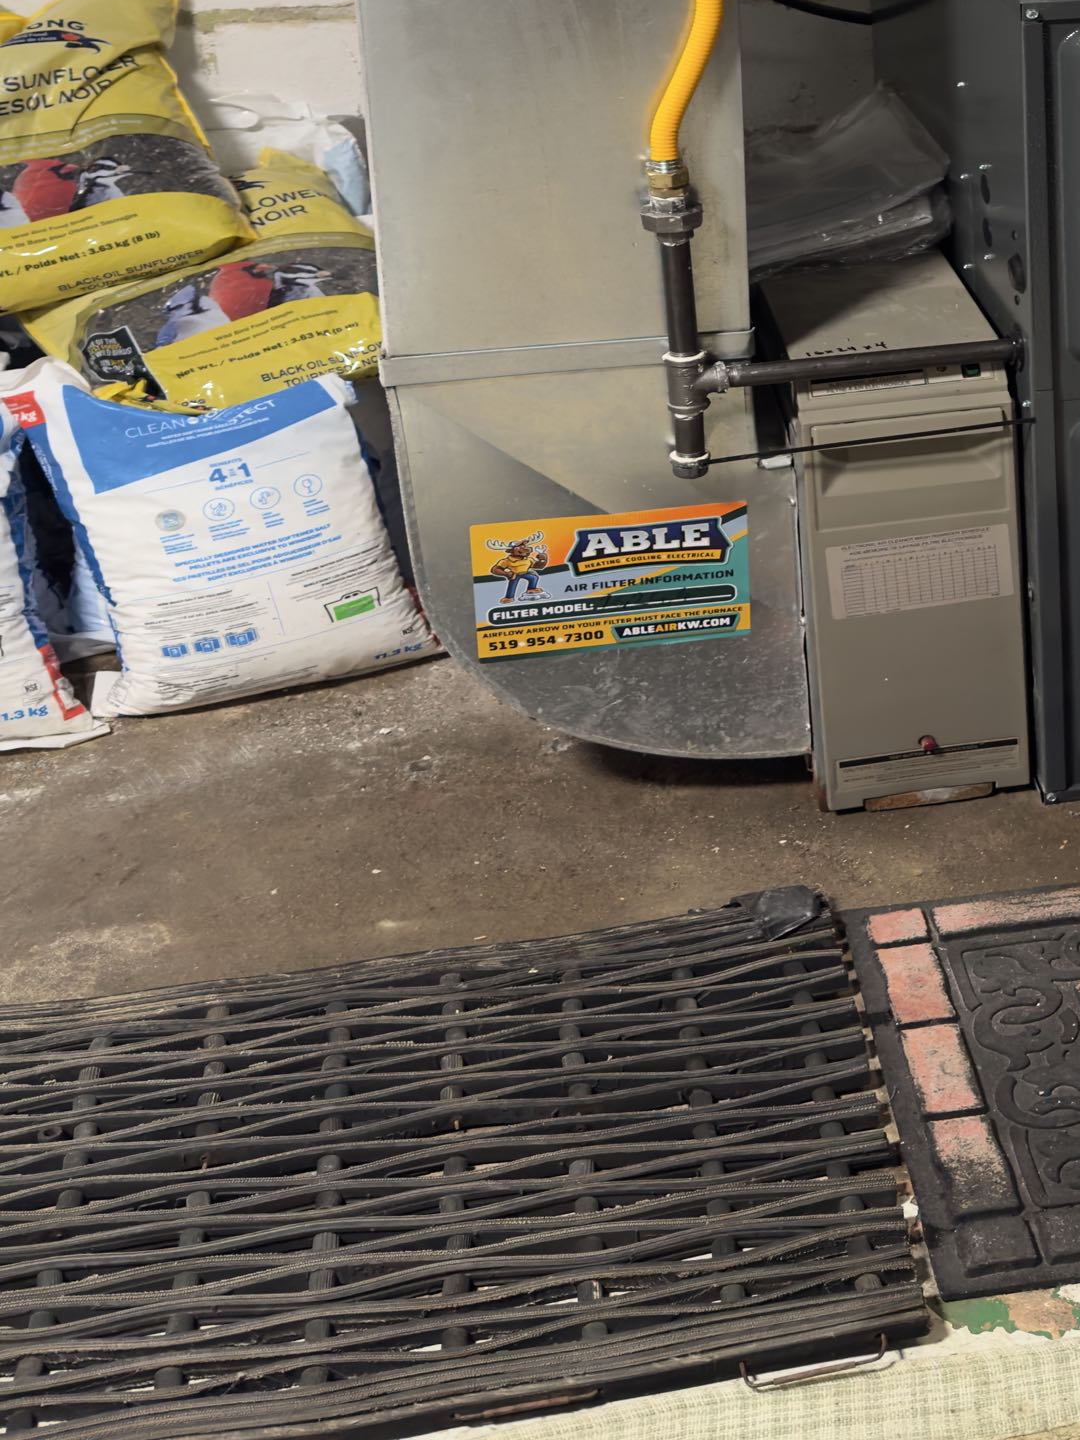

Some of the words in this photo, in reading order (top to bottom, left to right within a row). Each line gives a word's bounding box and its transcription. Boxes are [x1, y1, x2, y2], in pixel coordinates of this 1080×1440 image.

[24, 258, 57, 271] Poids
[59, 252, 80, 262] Net
[115, 238, 130, 249] kg
[58, 275, 100, 293] BLACK
[103, 269, 121, 279] OIL
[125, 249, 204, 273] SUNFLOWER
[261, 363, 305, 383] BLACK
[307, 357, 327, 371] OIL
[124, 417, 186, 440] CLEAN
[581, 522, 710, 558] ABLE
[584, 560, 622, 570] HEATING
[625, 554, 662, 563] COOLING
[666, 551, 716, 560] ELECTRICAL
[564, 583, 588, 593] AIR
[591, 578, 636, 591] FILTER
[639, 568, 734, 586] INFORMATION
[482, 629, 524, 639] AIRFLOW
[526, 625, 560, 635] ARROW
[577, 621, 602, 629] YOUR
[603, 617, 632, 626] FILTER
[634, 614, 658, 623] MUST
[702, 606, 743, 615] FURNACE
[492, 607, 538, 621] FILTER
[542, 602, 594, 616] MODEL:
[622, 617, 731, 637] ABLEAIRKW.COM
[28, 703, 49, 717] kg
